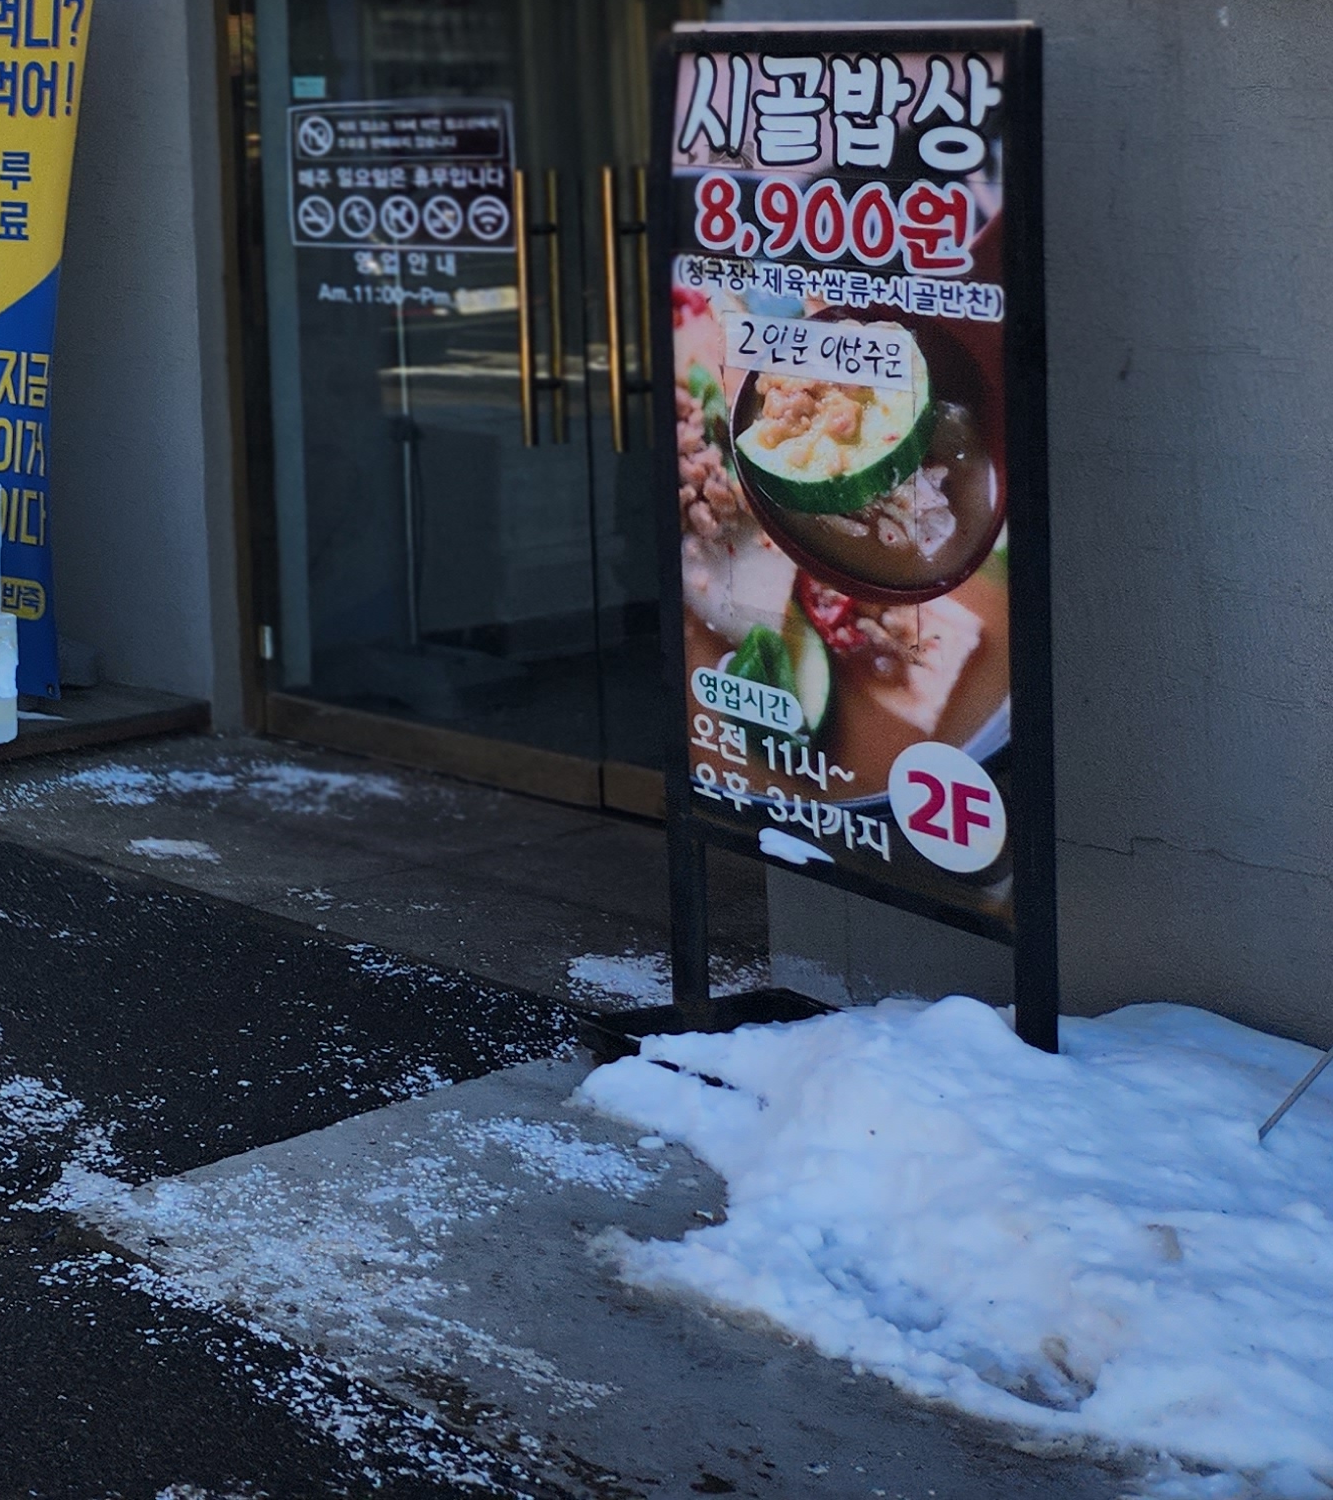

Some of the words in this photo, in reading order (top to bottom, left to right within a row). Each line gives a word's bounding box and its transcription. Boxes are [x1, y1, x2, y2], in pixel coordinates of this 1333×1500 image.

[678, 53, 1003, 172] 시골밥상
[298, 168, 332, 189] 매주
[337, 166, 407, 190] 일요일은
[413, 166, 505, 189] 휴무입니다
[697, 175, 970, 272] 8,900원
[678, 257, 1004, 318] (청국장+제육+쌈류+시골반찬)
[697, 671, 791, 727] 영업시간
[690, 712, 748, 766] 오전
[761, 734, 855, 791] 11시~
[693, 761, 752, 813] 오후
[765, 784, 891, 863] 3시까지
[906, 769, 992, 848] 2F
